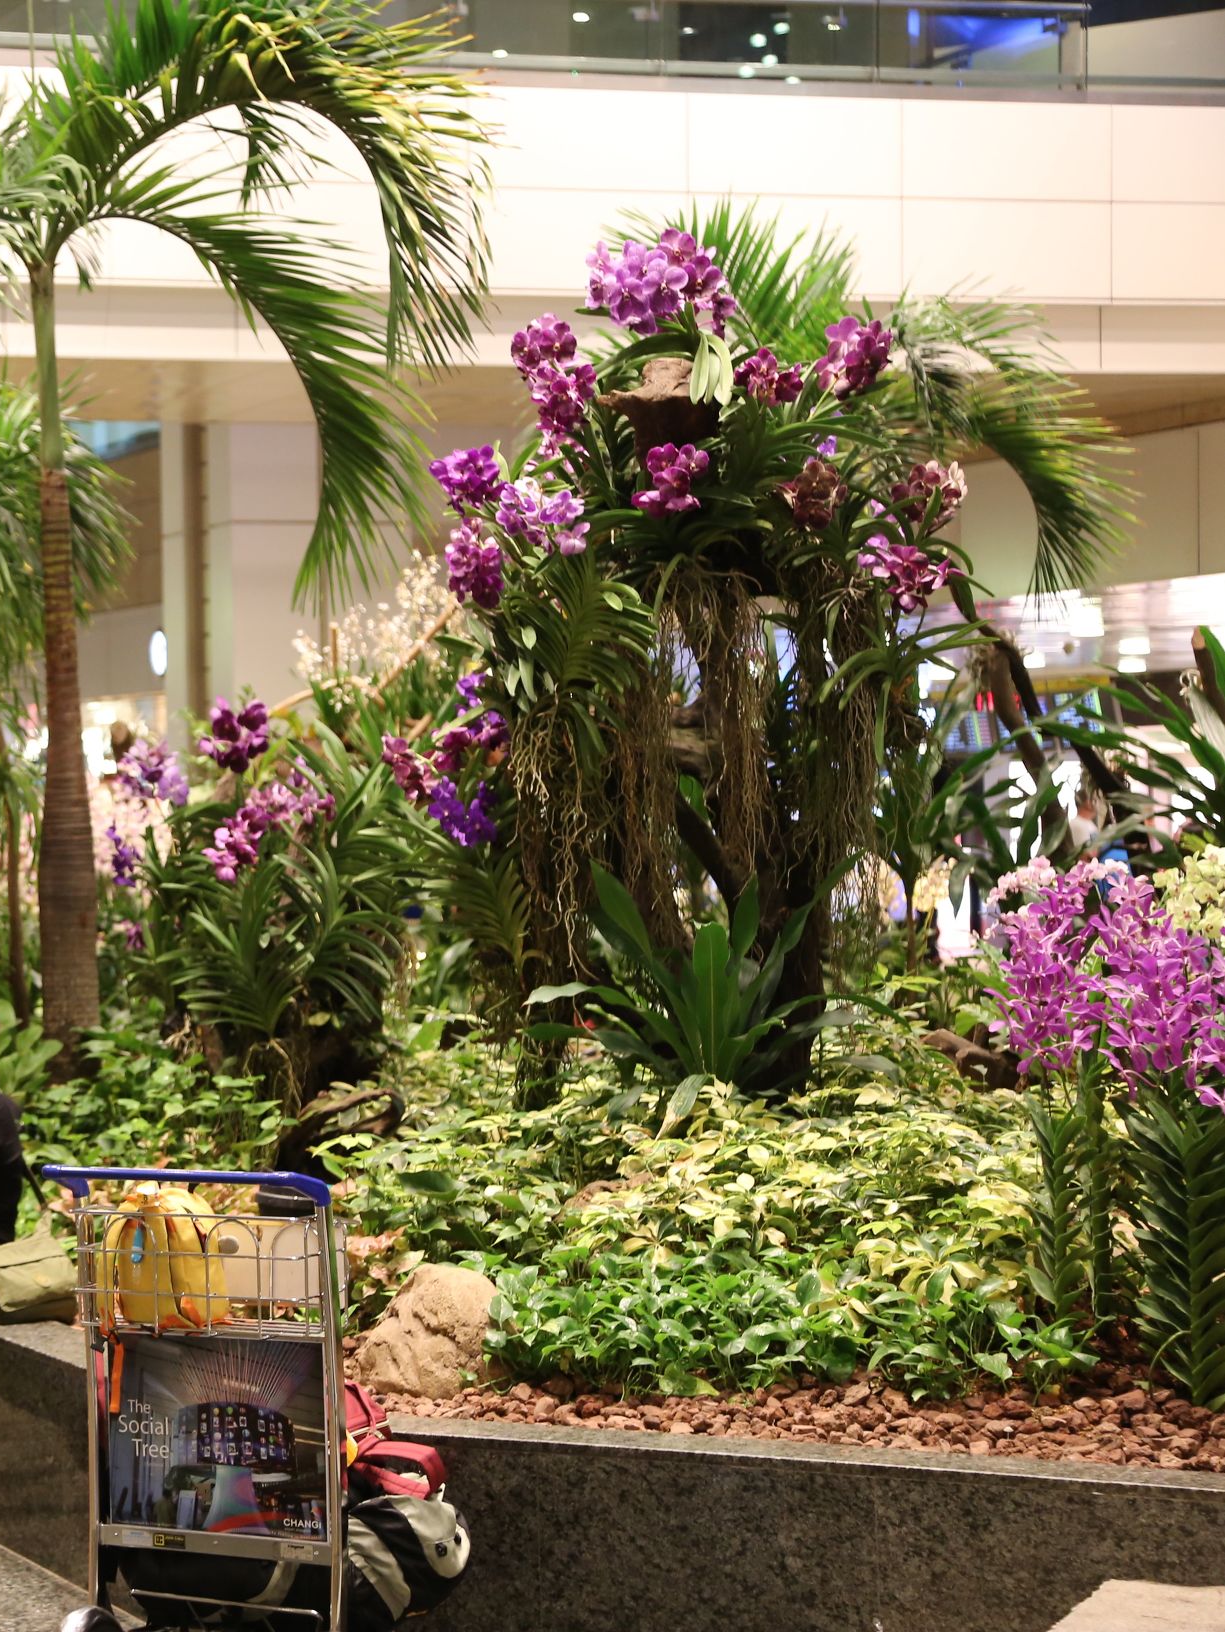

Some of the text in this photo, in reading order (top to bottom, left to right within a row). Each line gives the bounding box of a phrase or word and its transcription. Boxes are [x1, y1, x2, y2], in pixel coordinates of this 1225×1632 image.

[127, 1399, 151, 1414] The
[118, 1414, 169, 1435] Social
[131, 1438, 170, 1459] Tree
[283, 1518, 322, 1529] CHANGI
